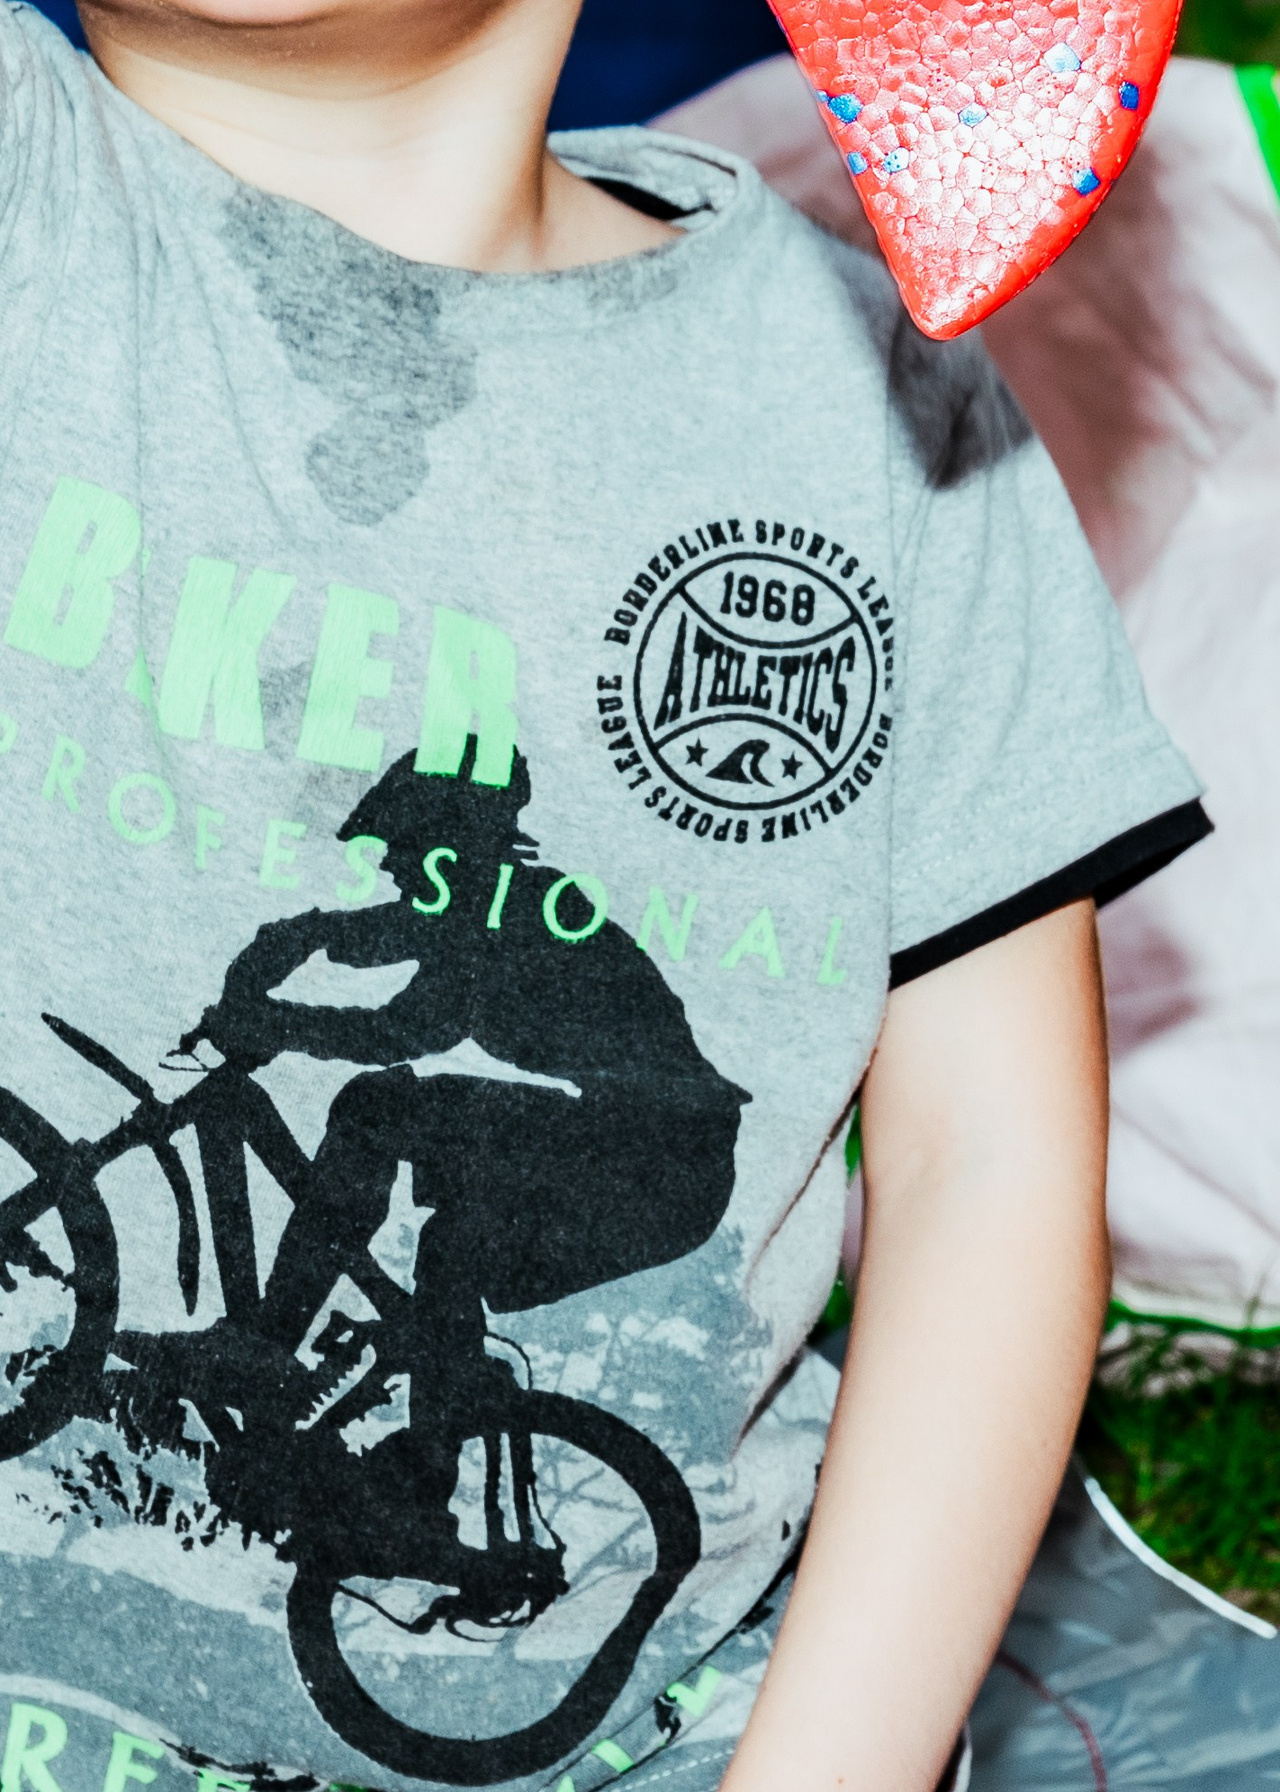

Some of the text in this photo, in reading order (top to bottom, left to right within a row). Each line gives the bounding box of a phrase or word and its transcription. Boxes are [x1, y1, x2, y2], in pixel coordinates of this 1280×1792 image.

[4, 476, 520, 788] BKER
[604, 519, 744, 645] BORDERLINE
[755, 519, 859, 579] SPORTS
[720, 571, 816, 626] 1968
[653, 611, 857, 753] ATHLETICS
[597, 675, 893, 844] BORDERLINE SPORTS LEAGUE
